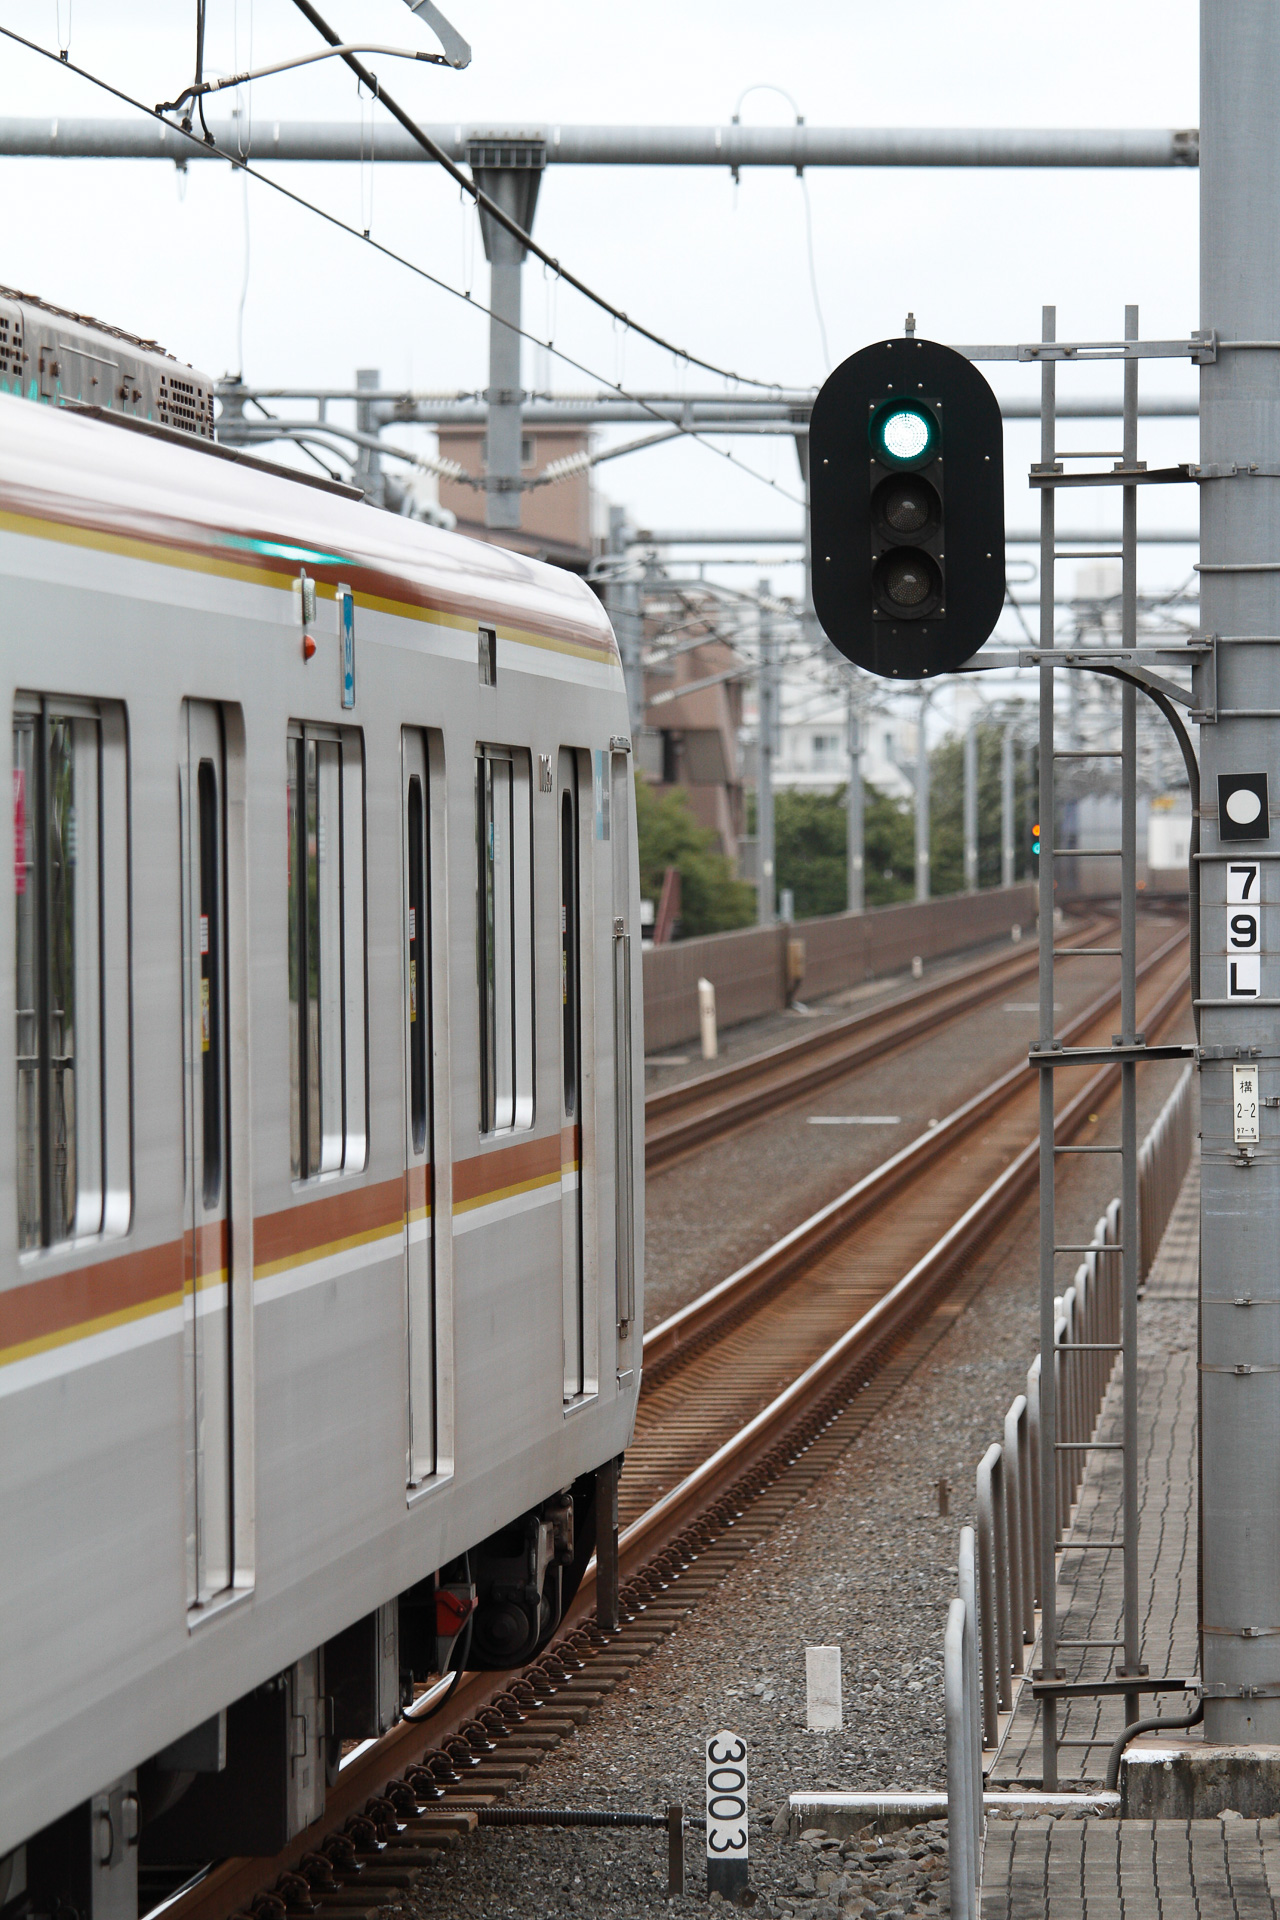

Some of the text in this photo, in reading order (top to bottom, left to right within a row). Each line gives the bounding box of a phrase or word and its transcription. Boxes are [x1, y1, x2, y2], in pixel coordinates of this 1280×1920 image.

[1239, 1080, 1253, 1094] 構
[1236, 1102, 1256, 1119] 2-2
[708, 1739, 747, 1853] 3003
